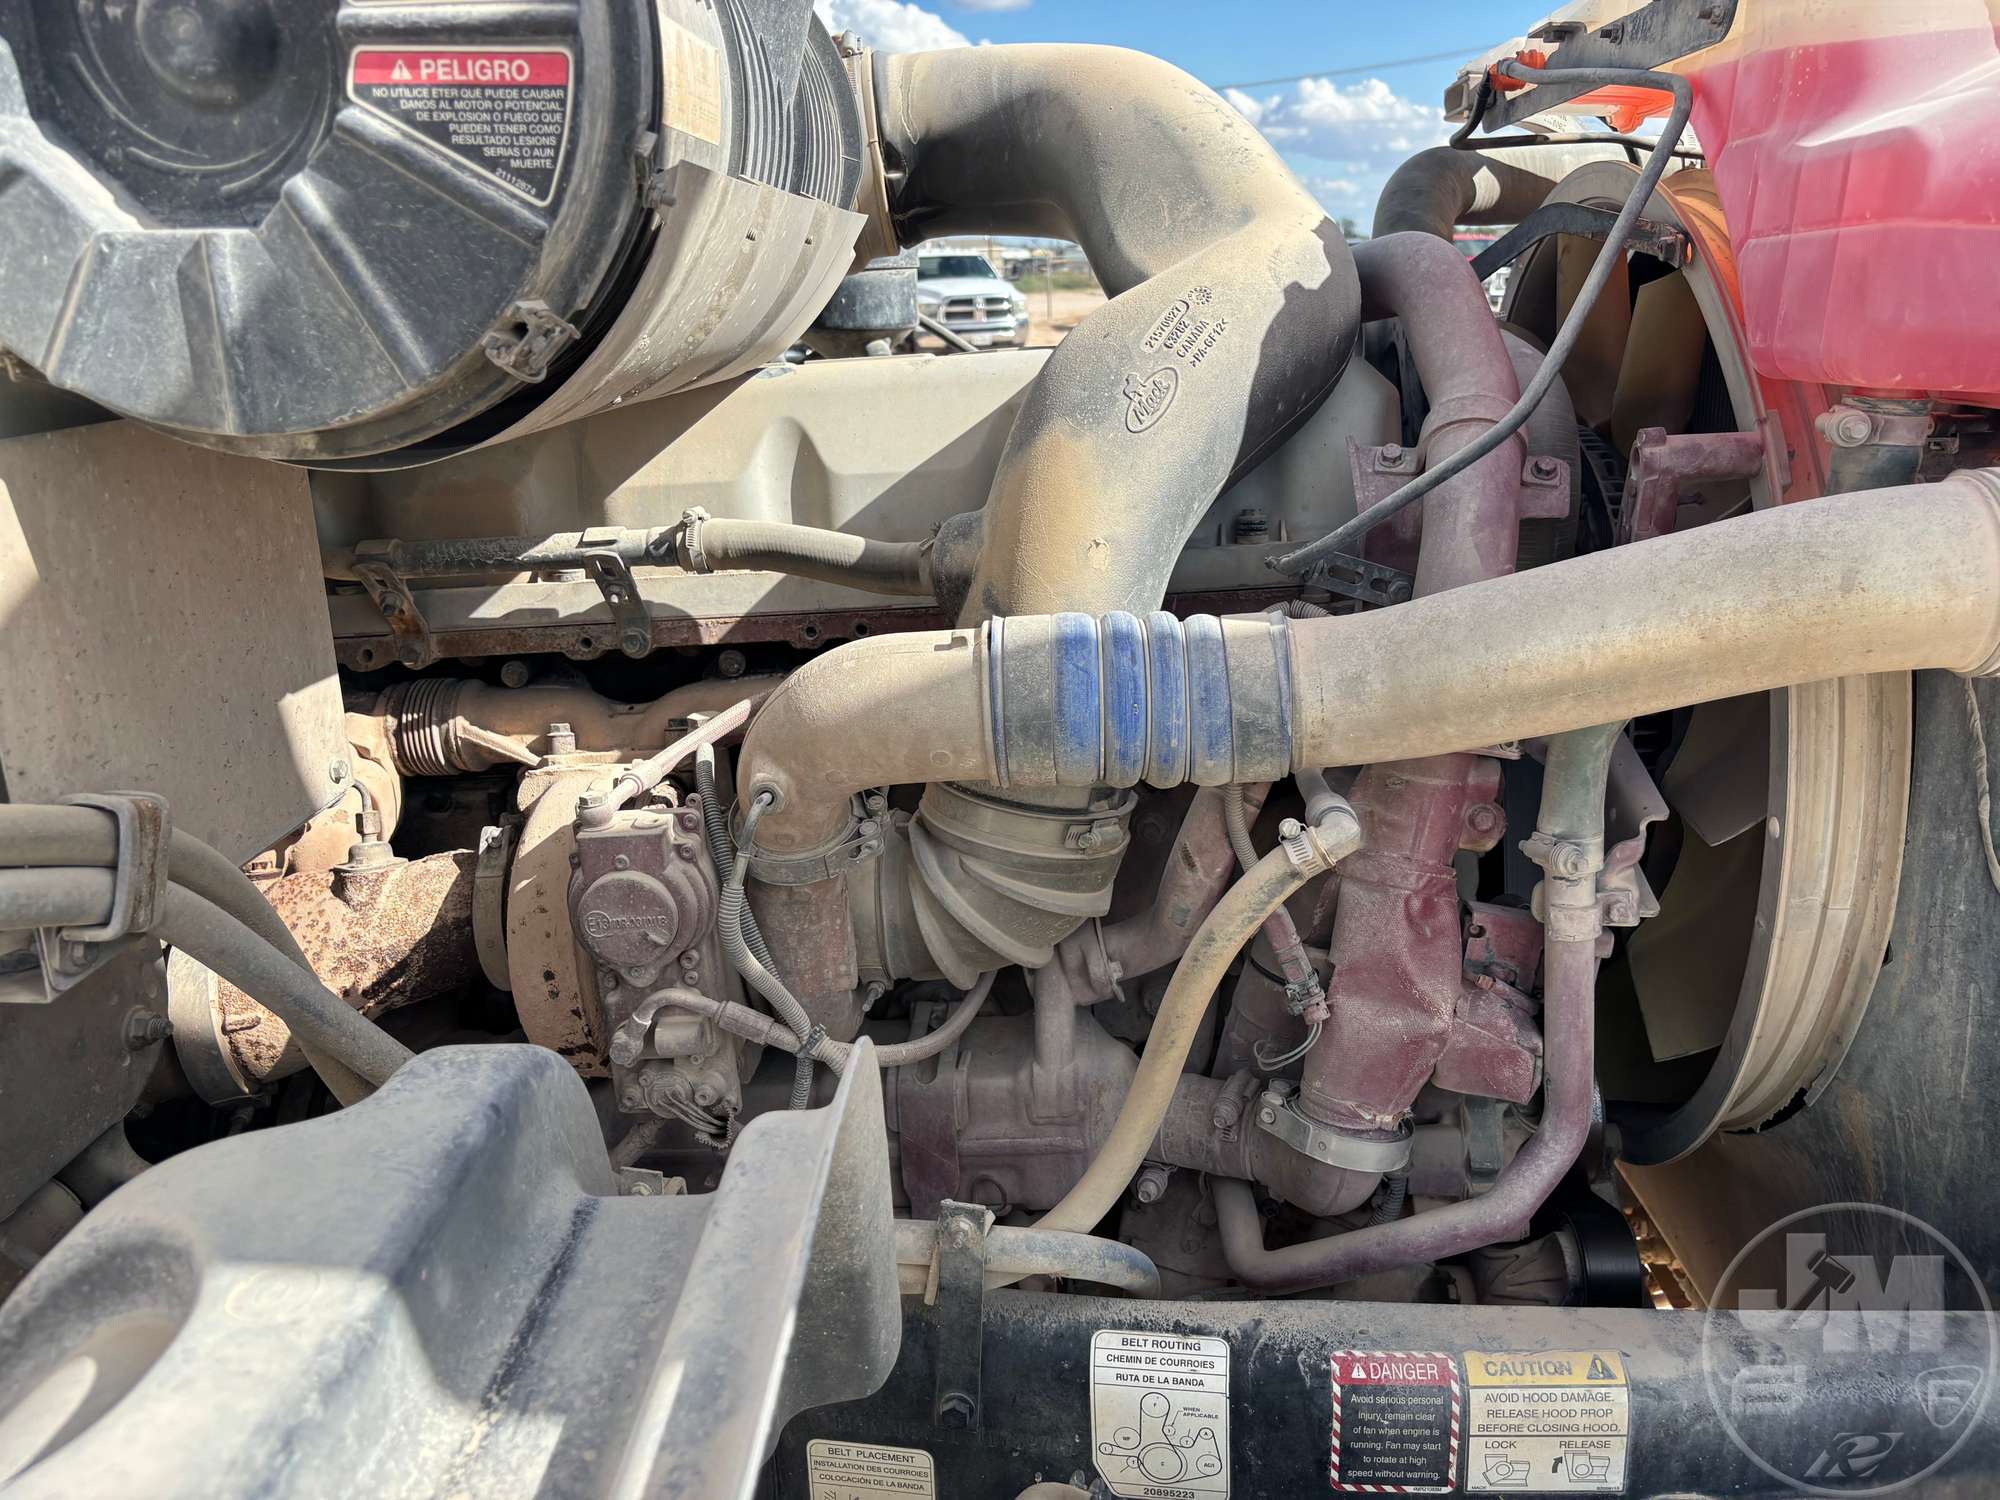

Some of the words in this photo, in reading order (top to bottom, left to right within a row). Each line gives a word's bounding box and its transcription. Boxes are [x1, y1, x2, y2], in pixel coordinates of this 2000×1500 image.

[420, 60, 530, 81] PELIGRO
[373, 88, 388, 97] NO
[391, 88, 429, 97] UTILICE
[432, 88, 458, 98] ETER
[461, 89, 482, 98] QUE
[485, 89, 519, 98] PUEDE
[523, 89, 564, 99] CAUSAR
[439, 100, 452, 110] AL
[455, 100, 492, 110] MOTOR
[495, 101, 502, 110] O
[417, 112, 430, 121] DE
[433, 112, 490, 121] EXPLOSION
[493, 112, 501, 121] O
[504, 112, 539, 122] FUEGO
[542, 112, 563, 123] QUE
[449, 124, 491, 133] PUEDEN
[494, 124, 526, 133] TENER
[529, 124, 560, 134] COMO
[452, 135, 510, 145] RESULTADO
[513, 136, 556, 145] LESIONS
[483, 147, 520, 157] SERIAS
[523, 148, 530, 157] O
[533, 148, 554, 157] AUN
[510, 159, 554, 169] MUERTE.
[1177, 320, 1209, 358] CANADA
[1133, 379, 1170, 425] Mack
[1122, 1338, 1148, 1347] BELT
[1152, 1340, 1201, 1351] ROUTING
[1107, 1354, 1142, 1364] CHEMIN
[1145, 1357, 1157, 1365] DE
[1160, 1358, 1215, 1368] COURROIES
[1370, 1363, 1439, 1380] DANGER
[1484, 1361, 1572, 1376] CAUTION
[1116, 1373, 1139, 1382] RUTA
[1142, 1375, 1154, 1383] DE
[1158, 1376, 1169, 1384] LA
[1173, 1377, 1204, 1387] BANDA
[1351, 1394, 1373, 1404] Avoid
[1376, 1396, 1405, 1404] serious
[1408, 1396, 1443, 1406] personal
[1484, 1393, 1519, 1403] AVOID
[1523, 1393, 1557, 1402] HOOD
[1561, 1392, 1615, 1402] DAMAGE.
[1487, 1410, 1539, 1419] RELEASE
[1542, 1409, 1577, 1418] HOOD
[1581, 1409, 1613, 1417] PROP
[1363, 1426, 1375, 1434] fan
[1403, 1429, 1431, 1437] engine
[1478, 1424, 1524, 1432] BEFORE
[1527, 1424, 1579, 1432] CLOSING
[1583, 1424, 1621, 1432] HOOD.
[1351, 1442, 1383, 1450] running.
[1403, 1443, 1420, 1451] may
[1423, 1442, 1441, 1450] start
[1485, 1441, 1517, 1449] LOCK
[1559, 1441, 1611, 1449] RELEASE
[828, 1448, 850, 1456] BELT
[857, 1450, 915, 1463] PLACEMENT
[1410, 1457, 1426, 1465] high
[814, 1460, 864, 1471] INSTALLATION
[884, 1468, 928, 1478] COURROIES
[1348, 1470, 1372, 1479] speed
[1406, 1471, 1440, 1480] warning.
[898, 1482, 924, 1490] BANDA
[1144, 1488, 1194, 1499] 20895223
